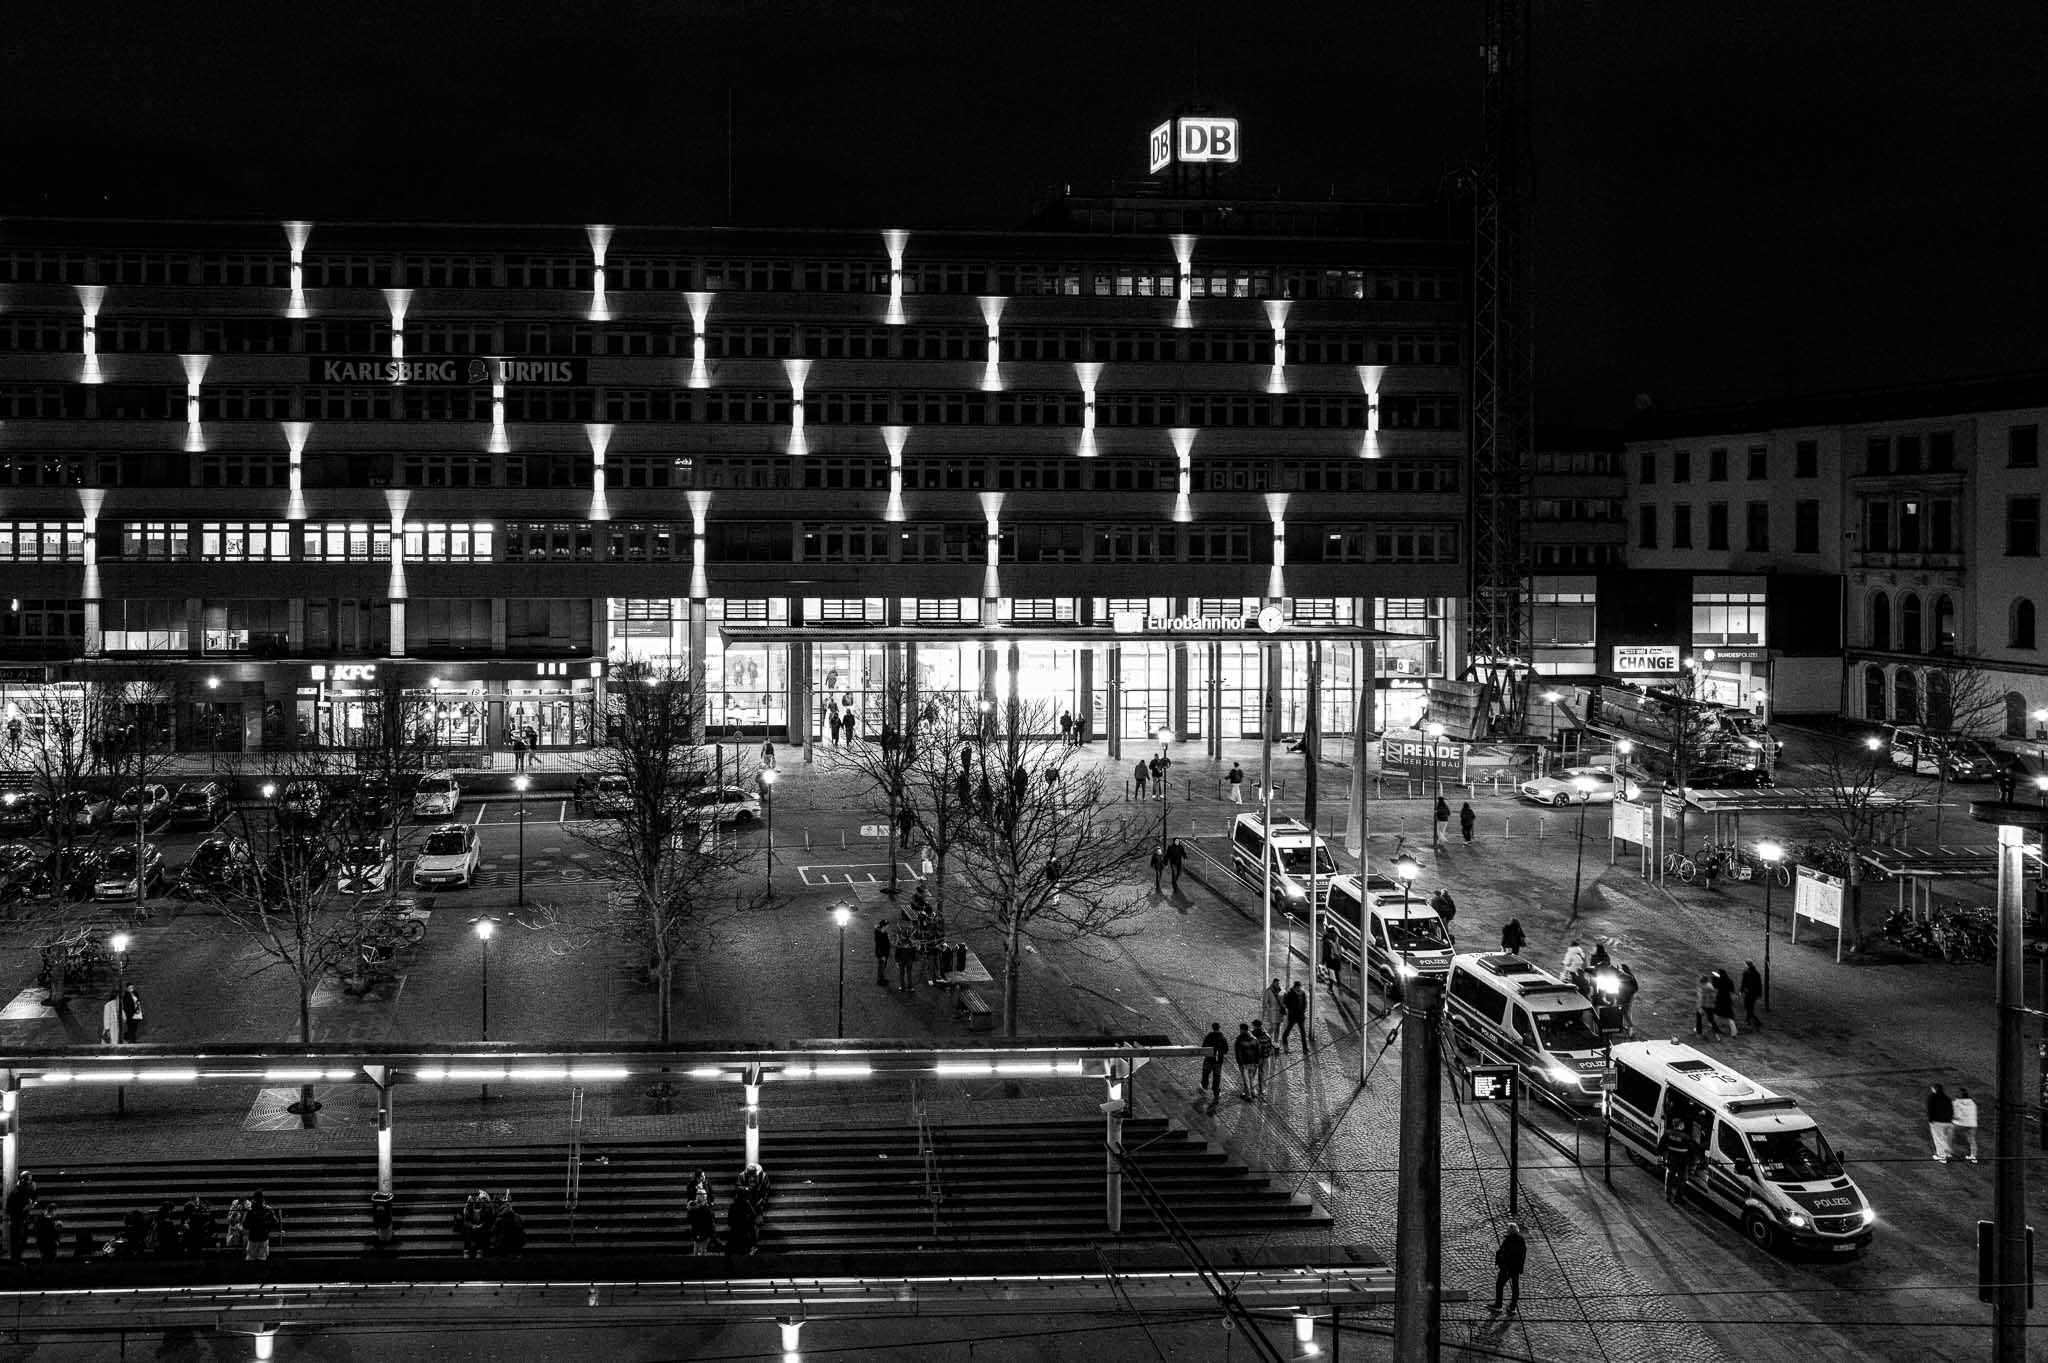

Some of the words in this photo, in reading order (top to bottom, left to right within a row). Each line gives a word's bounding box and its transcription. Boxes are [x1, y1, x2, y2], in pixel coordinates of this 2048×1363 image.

[1153, 130, 1169, 166] DB
[1185, 125, 1232, 155] DB
[324, 360, 456, 383] KARLSBERG
[498, 360, 574, 383] URPILS
[1149, 614, 1247, 630] Eurobahnhof
[1619, 656, 1674, 669] CHANGE
[333, 664, 377, 681] KFC
[1403, 743, 1460, 759] RENDE
[1814, 1197, 1852, 1209] POLIZEI
